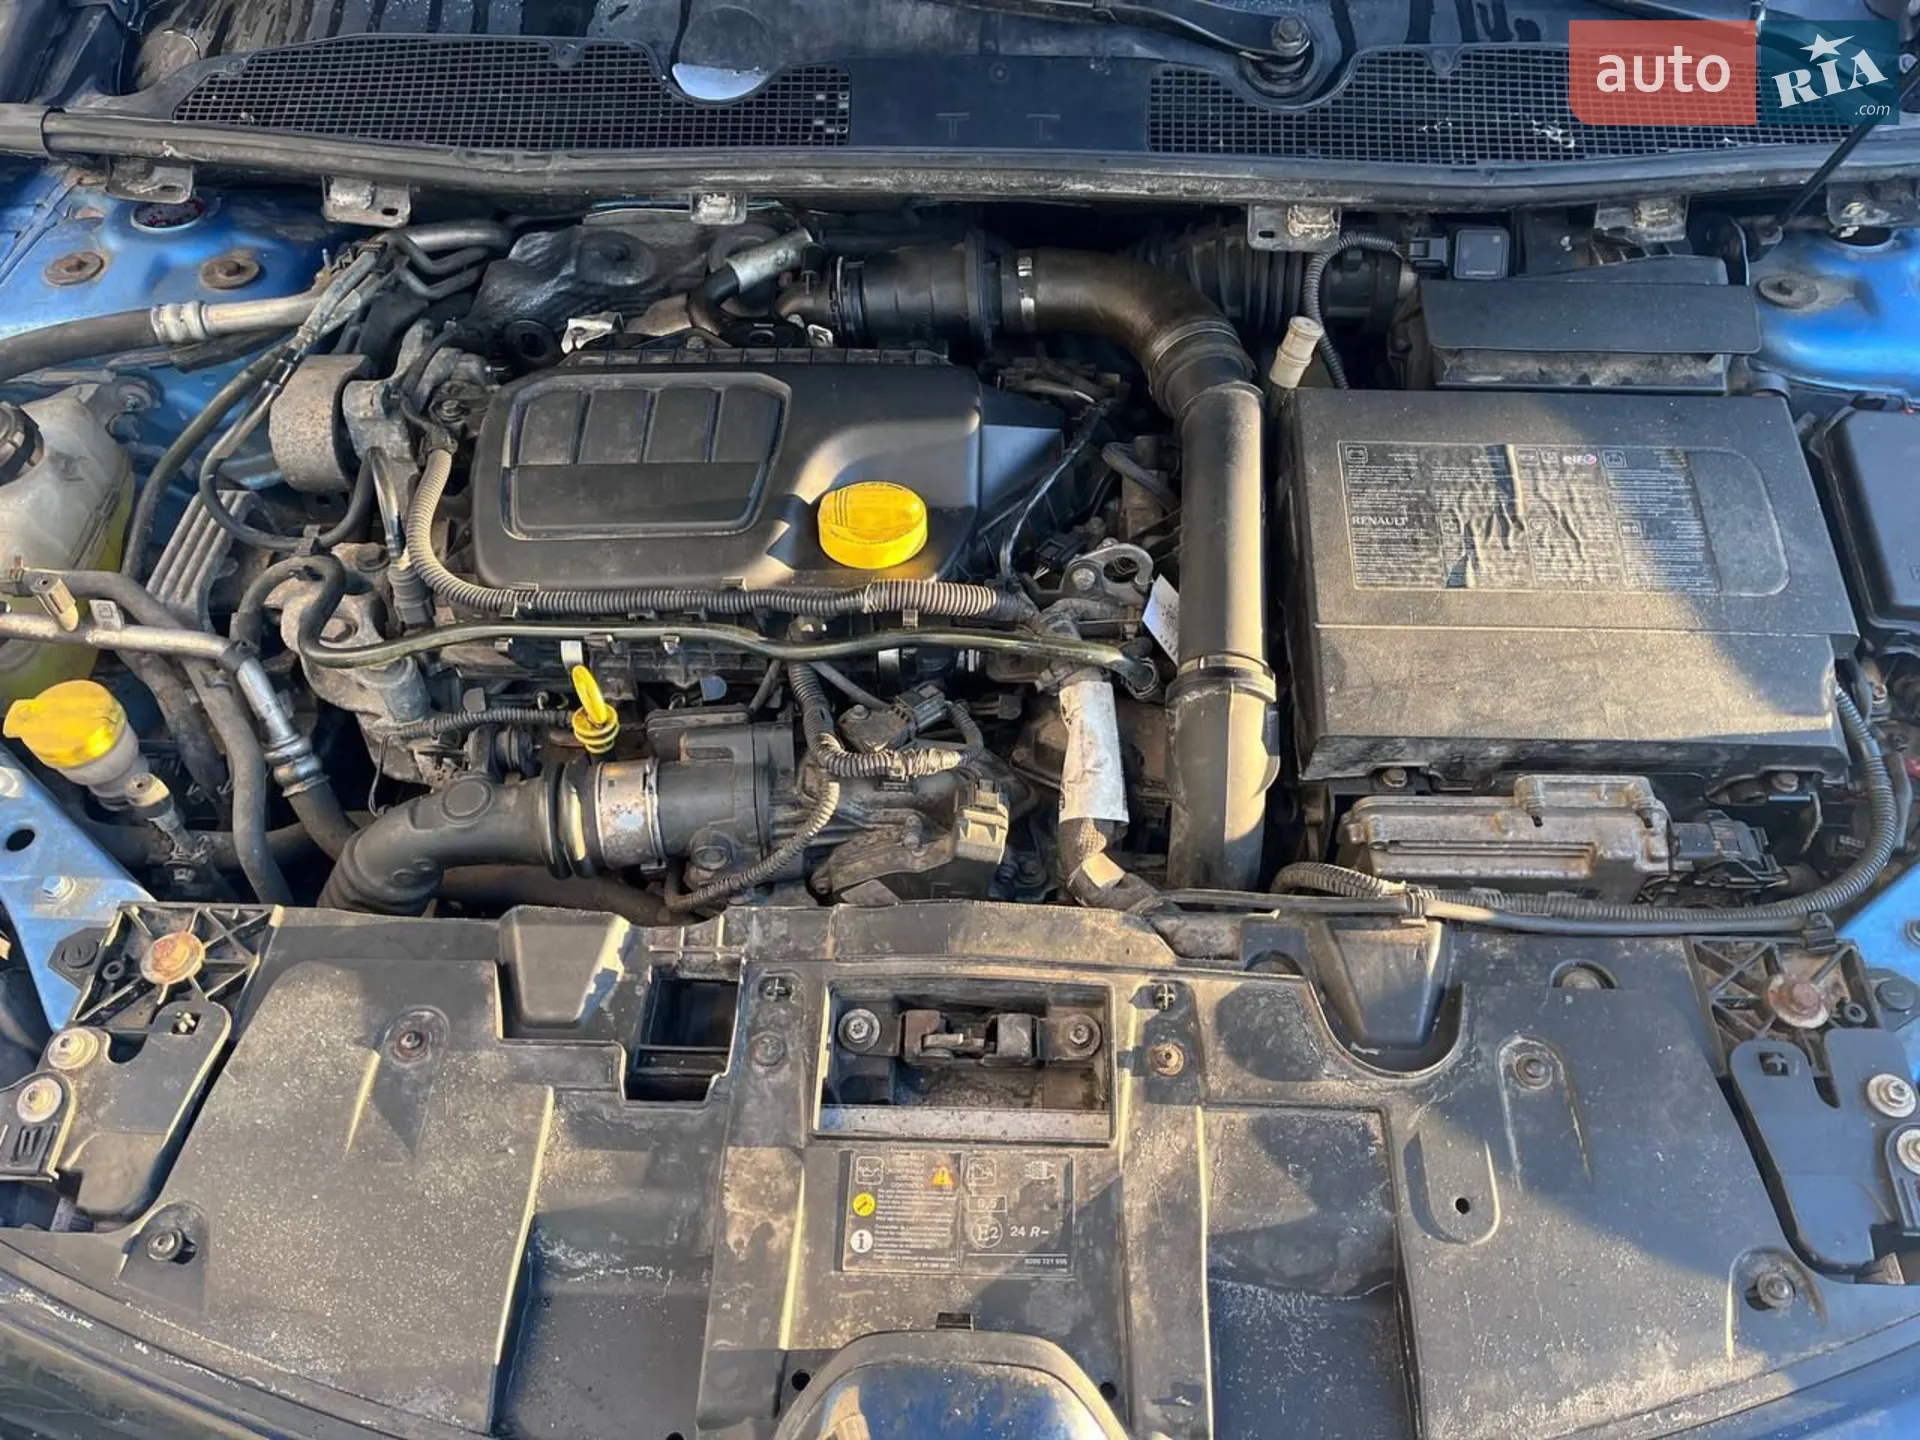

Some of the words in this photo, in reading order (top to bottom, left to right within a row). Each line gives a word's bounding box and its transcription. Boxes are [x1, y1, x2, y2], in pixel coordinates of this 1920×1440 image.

[1352, 515, 1408, 526] RENAULT
[977, 1223, 999, 1241] E2
[1010, 1225, 1026, 1237] 24
